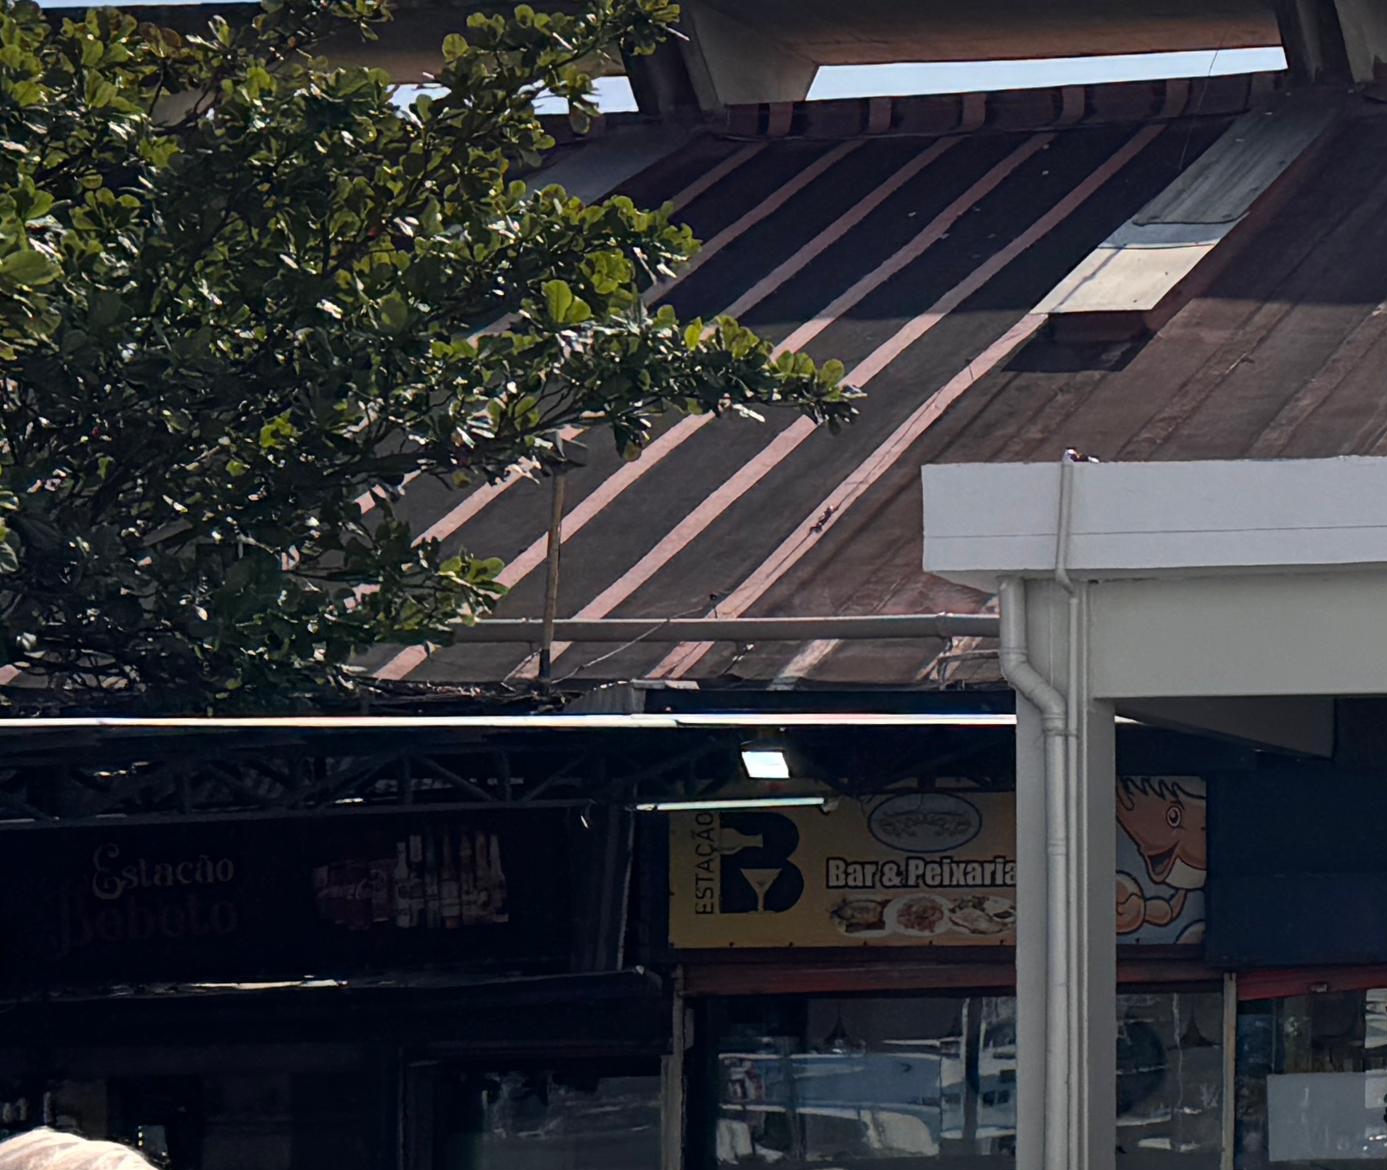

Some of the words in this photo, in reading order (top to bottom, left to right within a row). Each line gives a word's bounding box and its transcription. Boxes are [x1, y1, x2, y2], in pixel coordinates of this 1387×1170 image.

[691, 811, 718, 914] ESTAÇÃO
[827, 857, 878, 889] Bar
[881, 860, 907, 888] &
[906, 856, 1016, 888] Peixaria
